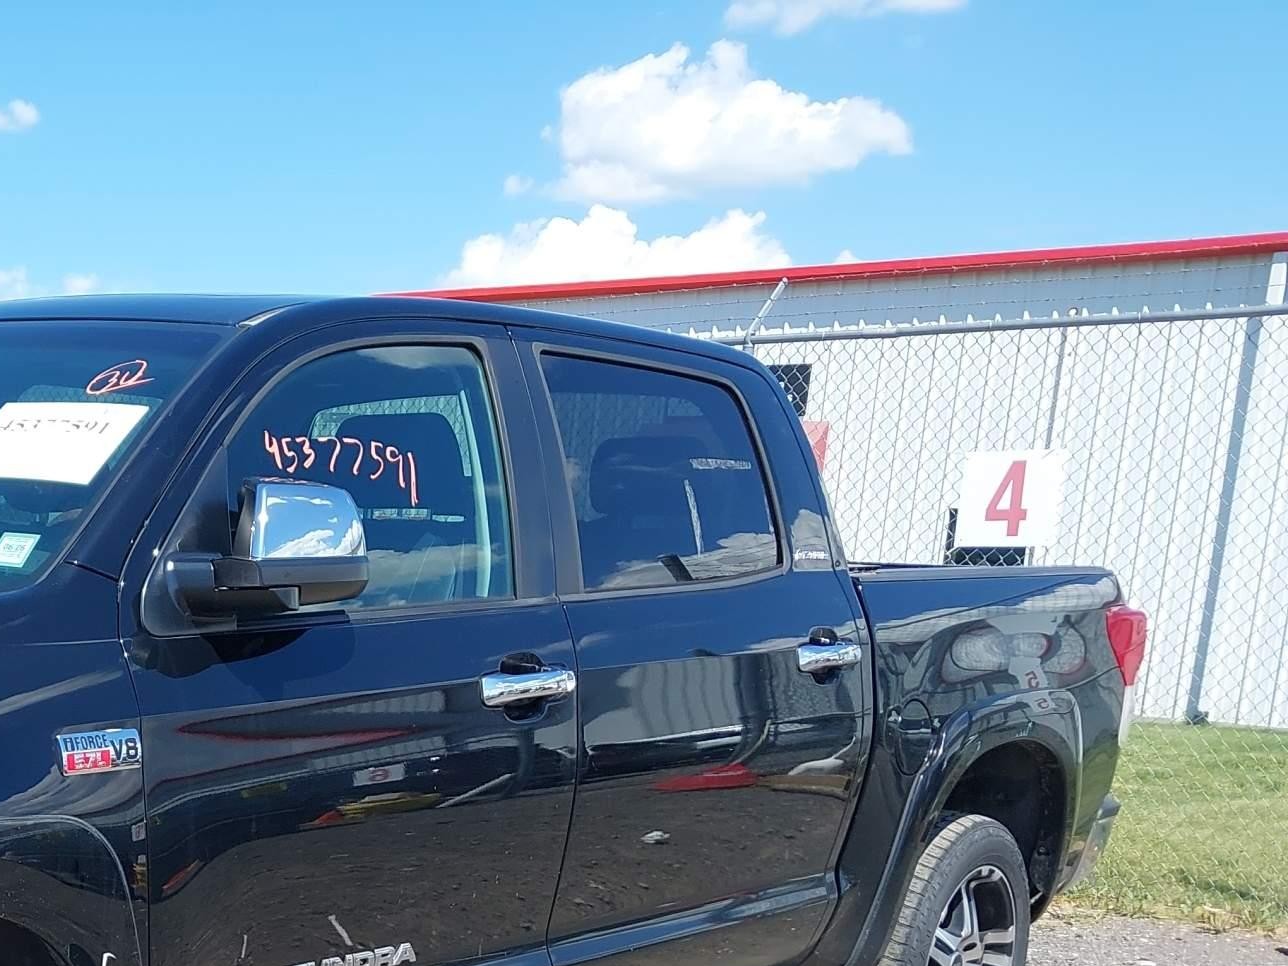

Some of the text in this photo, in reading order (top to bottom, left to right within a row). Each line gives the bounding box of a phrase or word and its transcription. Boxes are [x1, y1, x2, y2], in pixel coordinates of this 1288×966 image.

[264, 430, 418, 507] 45377591
[985, 460, 1028, 537] 4
[110, 737, 139, 764] V8
